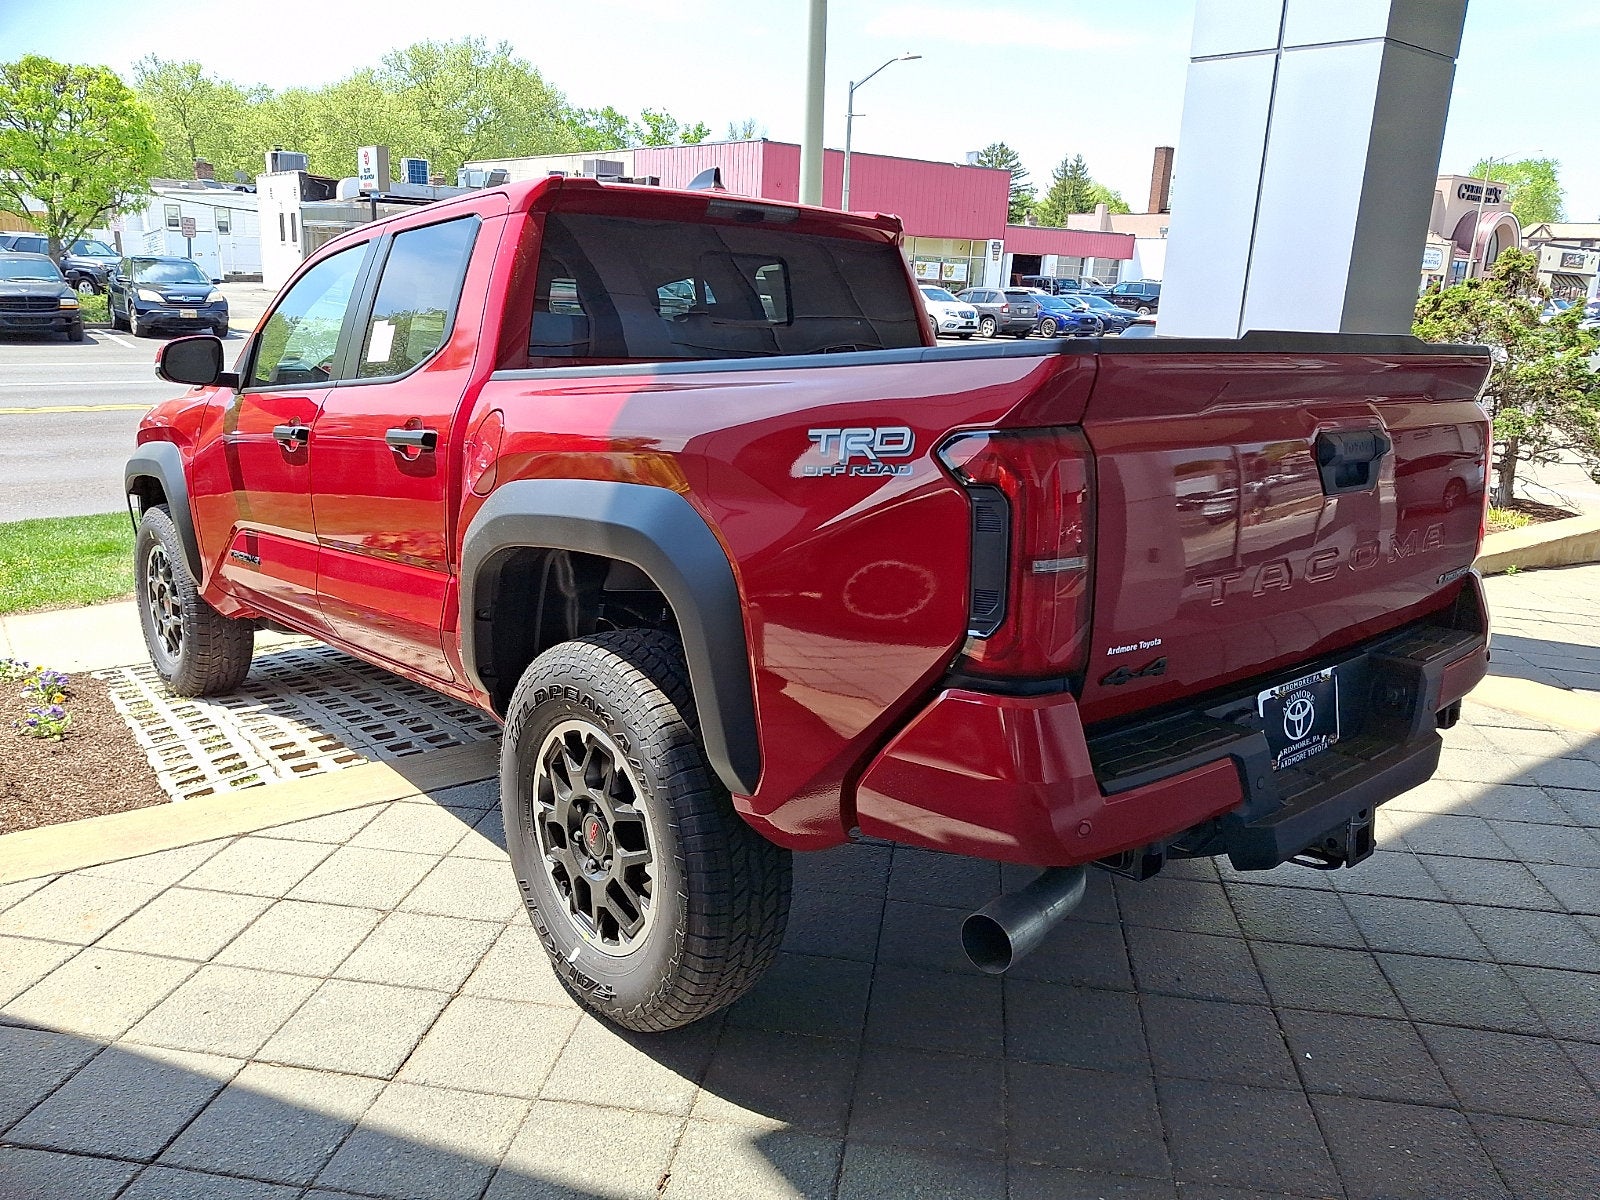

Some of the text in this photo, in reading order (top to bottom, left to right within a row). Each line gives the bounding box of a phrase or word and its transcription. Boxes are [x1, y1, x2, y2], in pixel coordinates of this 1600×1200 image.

[808, 426, 915, 464] TRD
[803, 463, 914, 477] OFF ROAD
[1194, 522, 1447, 606] TACOMA
[1106, 638, 1162, 656] Ardmore Toyota
[1282, 690, 1316, 716] ARDMORE
[509, 683, 615, 753] WILDPEAK
[1312, 734, 1321, 743] PA
[1280, 742, 1328, 770] ARDMORE TOYOTA
